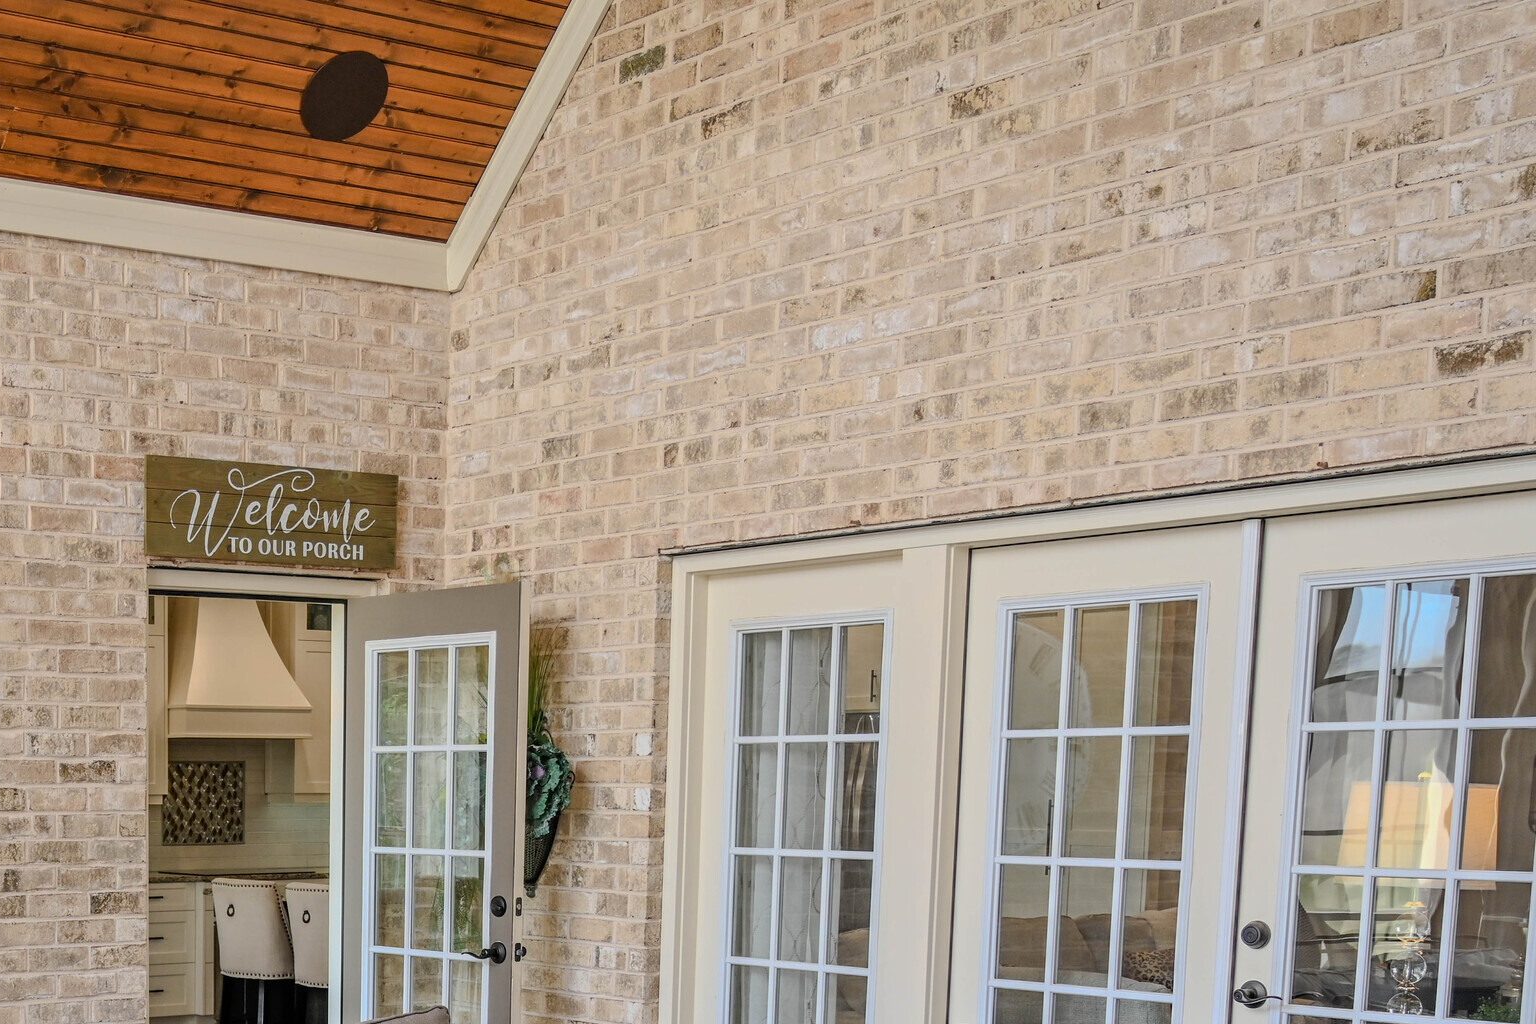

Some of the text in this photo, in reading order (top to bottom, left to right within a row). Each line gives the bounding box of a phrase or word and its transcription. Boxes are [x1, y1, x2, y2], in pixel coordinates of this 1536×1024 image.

[170, 468, 376, 557] Welcome
[228, 537, 364, 561] TO OUR PORCH
